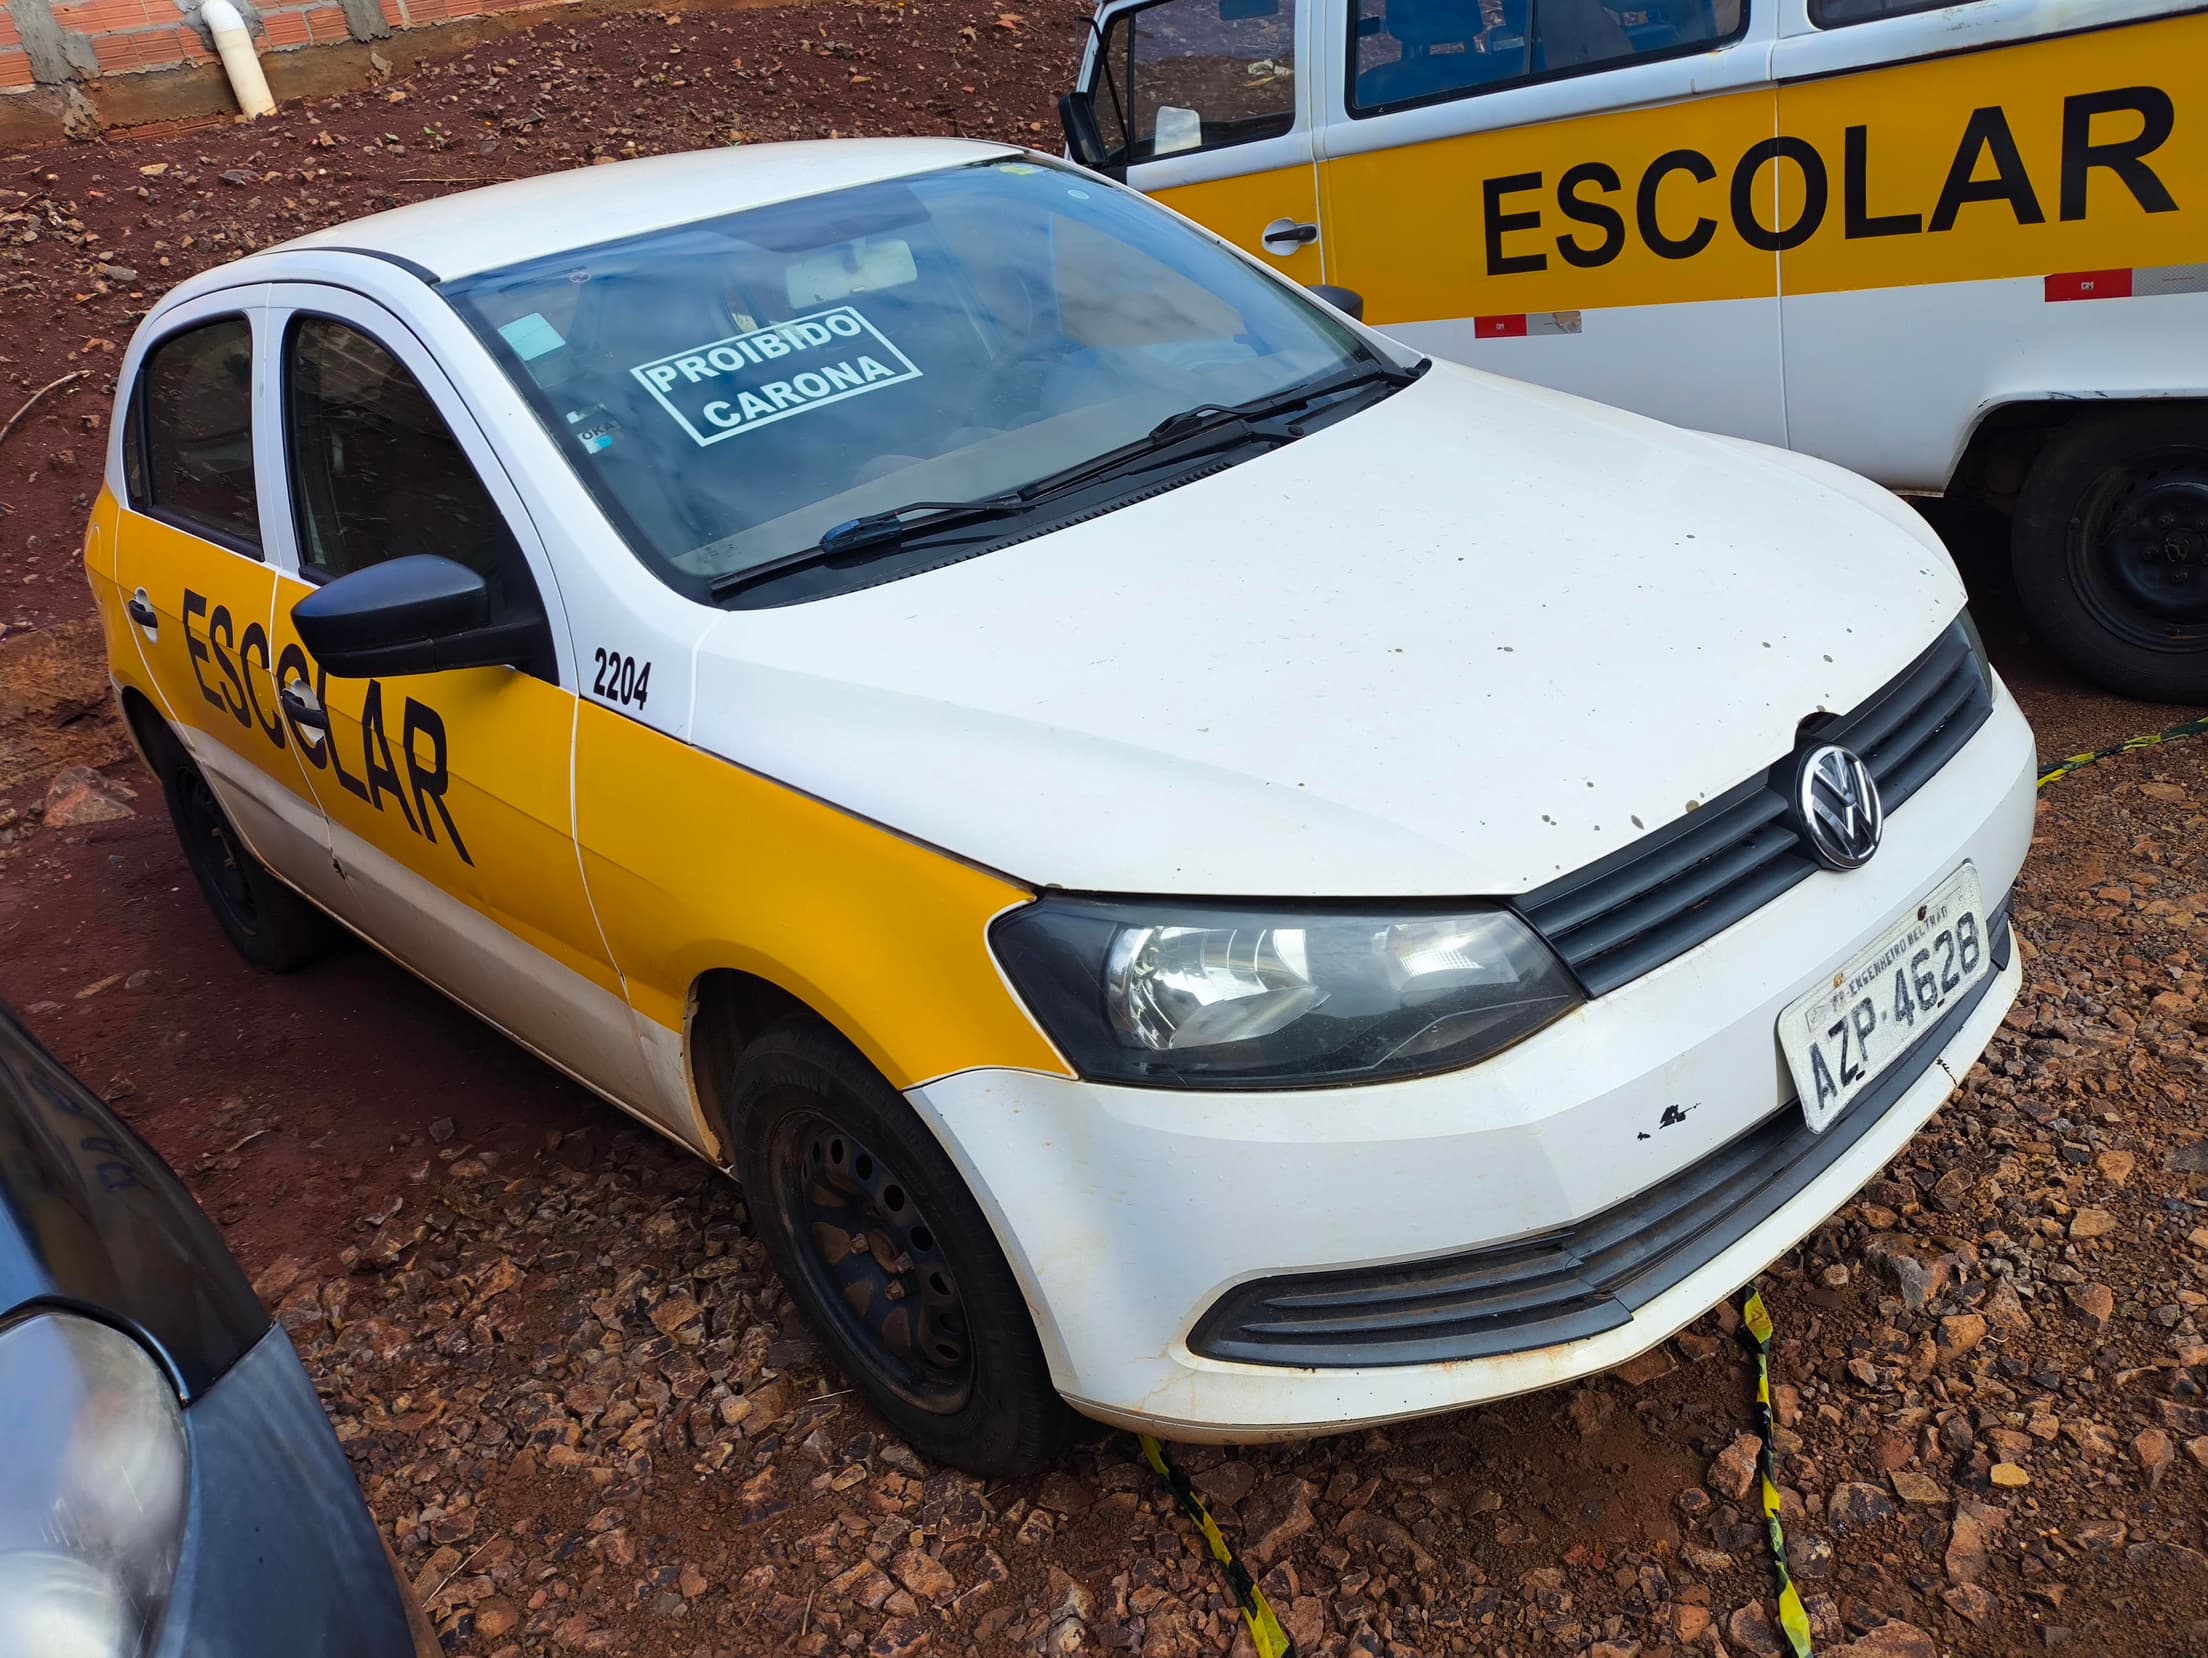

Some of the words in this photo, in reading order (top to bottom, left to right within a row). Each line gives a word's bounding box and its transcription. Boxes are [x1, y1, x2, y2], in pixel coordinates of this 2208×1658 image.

[1483, 85, 2180, 276] ESCOLAR
[645, 313, 863, 393] PROIBIDO
[703, 355, 896, 429] CARONA
[593, 647, 651, 711] 2204
